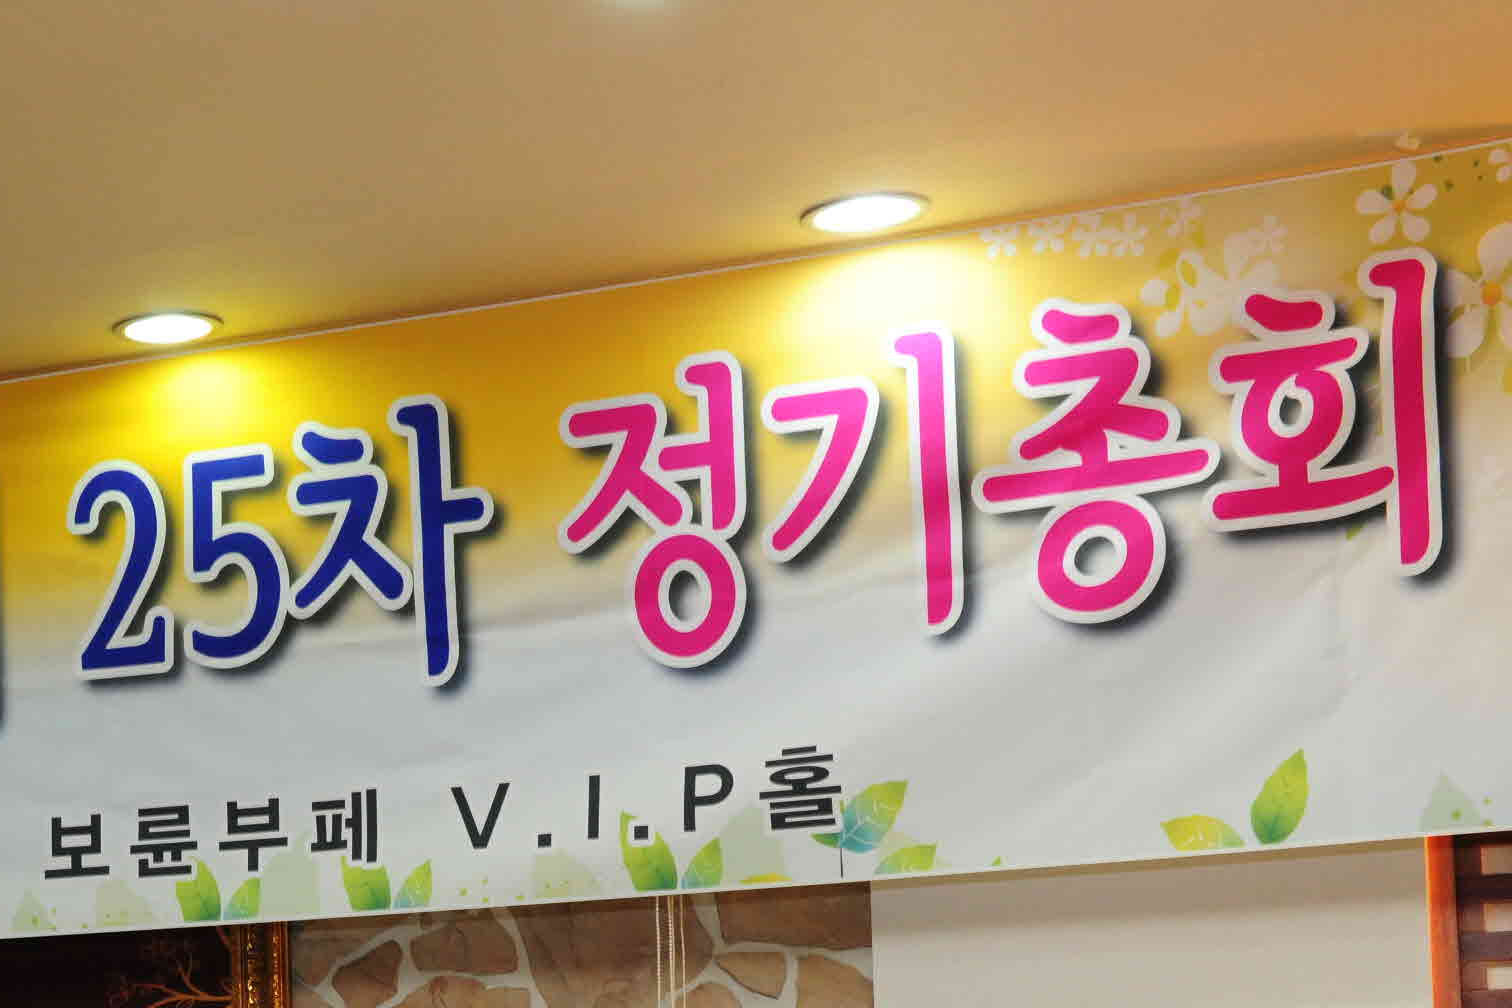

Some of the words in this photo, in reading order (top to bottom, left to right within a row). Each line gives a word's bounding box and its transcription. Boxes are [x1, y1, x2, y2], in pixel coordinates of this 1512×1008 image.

[72, 402, 486, 679] 25차
[566, 257, 1437, 659] 정기총회
[44, 788, 378, 880] 보륜부페
